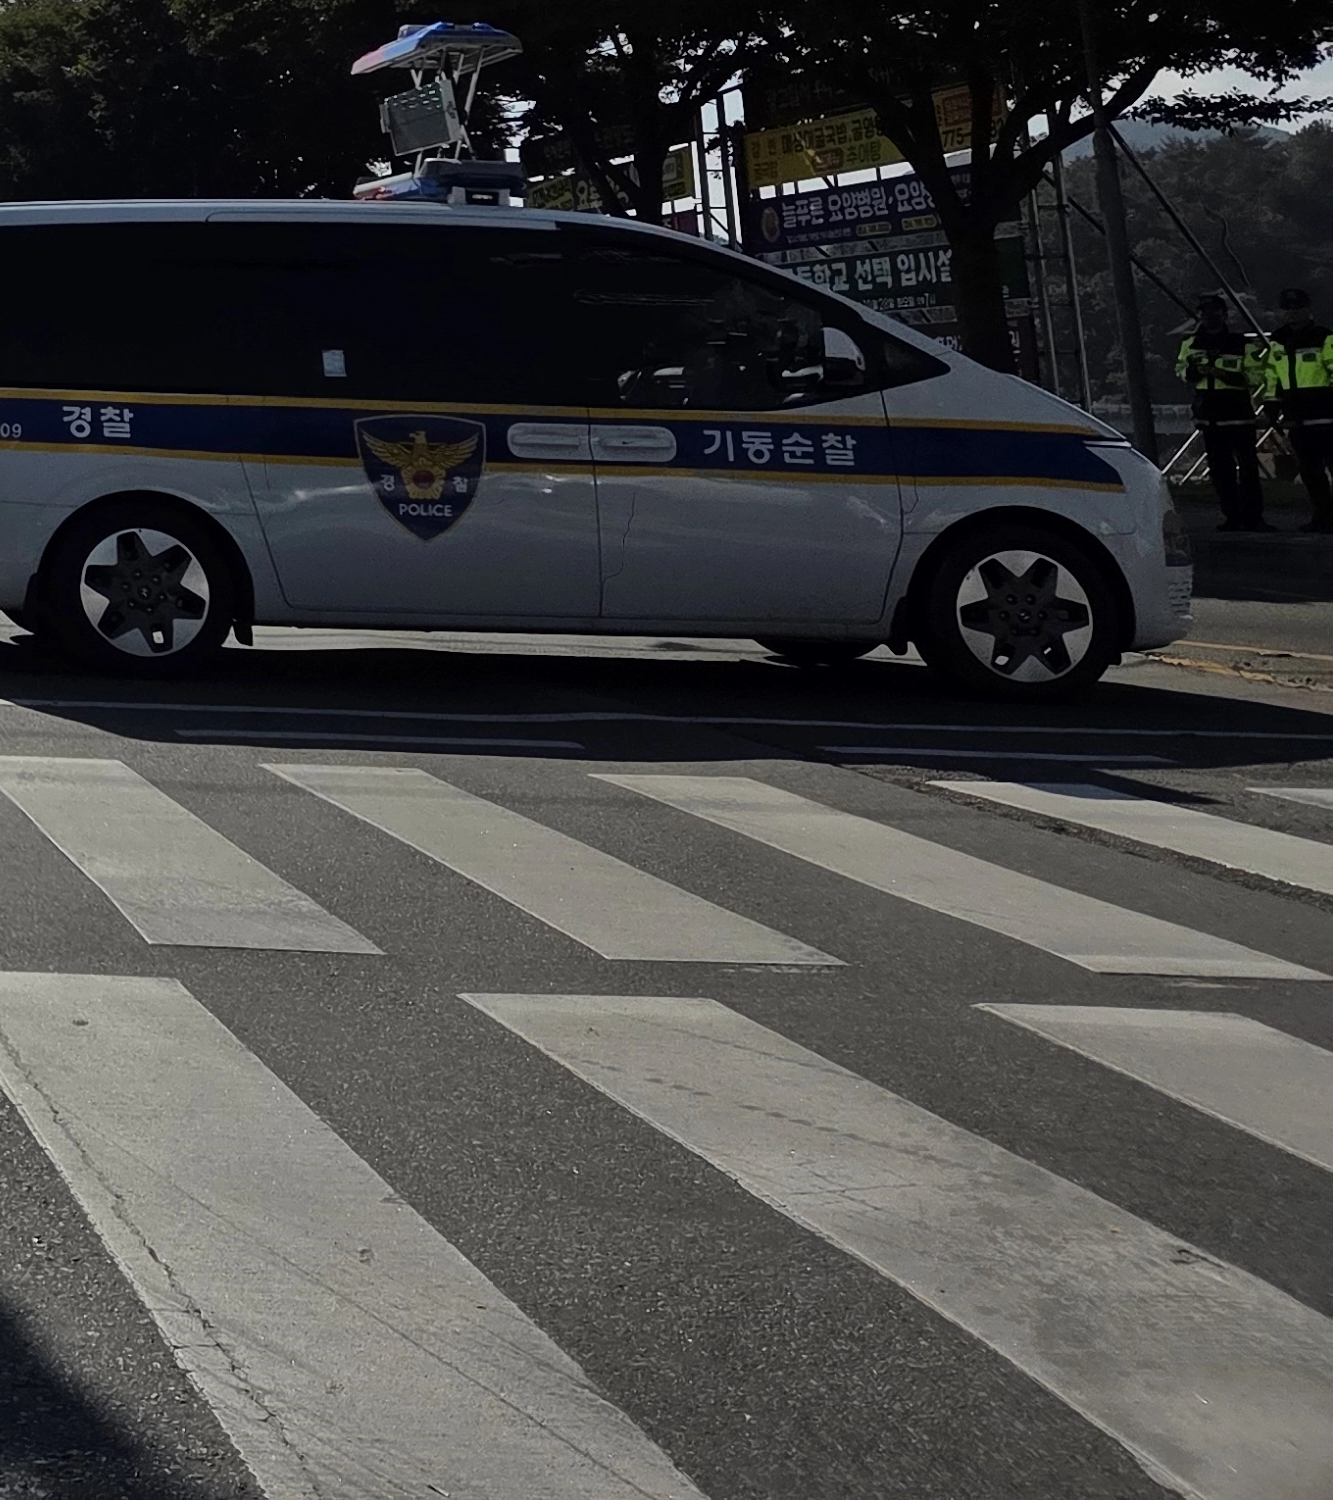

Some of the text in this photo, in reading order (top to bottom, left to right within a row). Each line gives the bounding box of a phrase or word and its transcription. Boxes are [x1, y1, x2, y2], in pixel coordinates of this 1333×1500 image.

[782, 197, 825, 229] 늘푸른
[783, 261, 850, 292] 등학교
[854, 256, 893, 291] 선택
[62, 406, 134, 438] 경찰
[703, 429, 857, 467] 기동순찰
[380, 473, 395, 491] 경
[399, 503, 453, 518] POLICE
